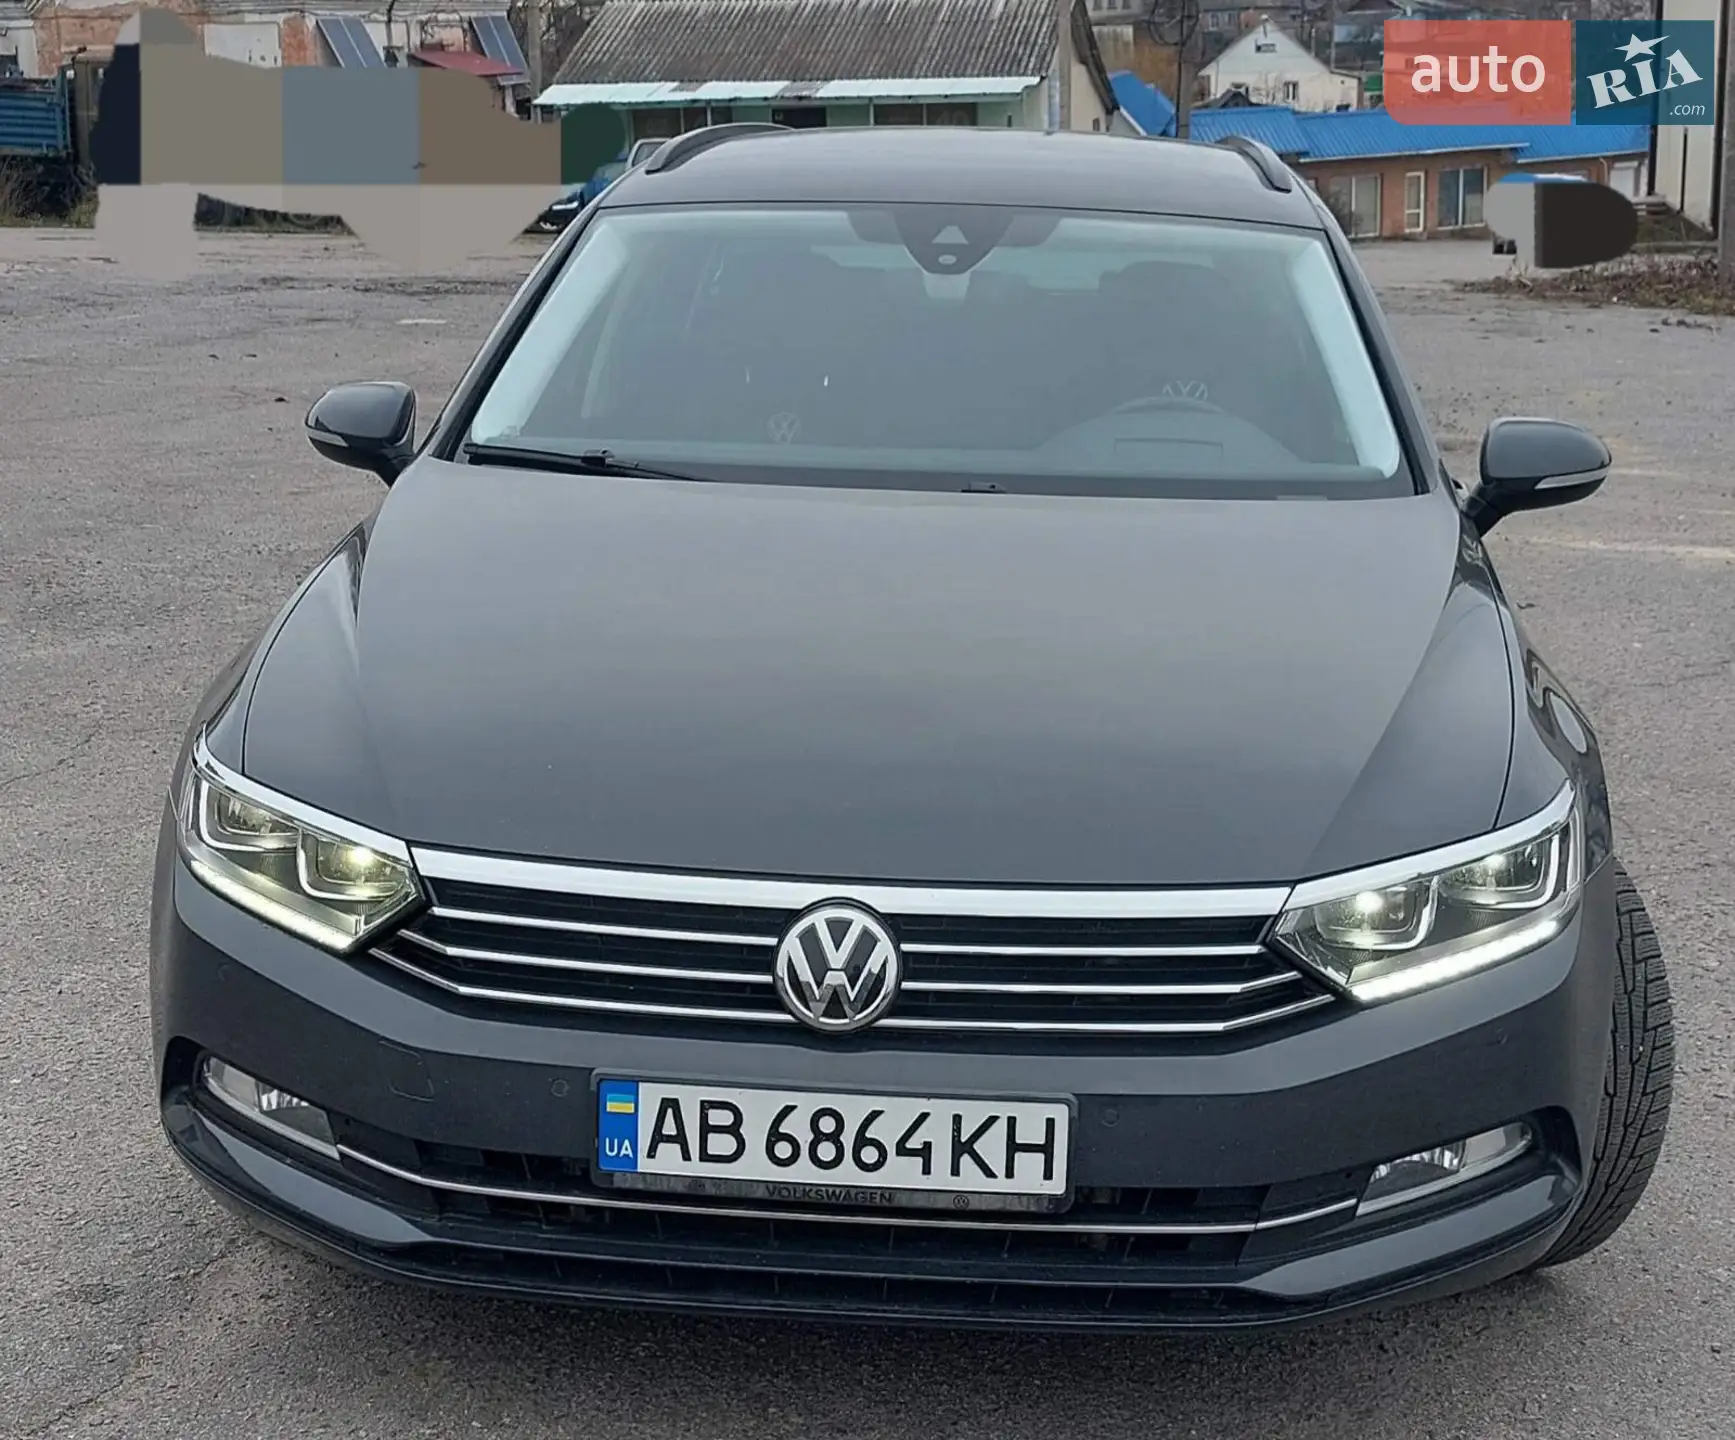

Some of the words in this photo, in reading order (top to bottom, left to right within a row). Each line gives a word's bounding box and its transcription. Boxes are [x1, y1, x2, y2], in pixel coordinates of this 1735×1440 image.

[605, 1138, 633, 1158] UA
[647, 1097, 746, 1163] AB
[765, 1105, 932, 1175] 6864
[950, 1114, 1056, 1180] KH
[766, 1185, 892, 1205] VOLKSWAGEN
